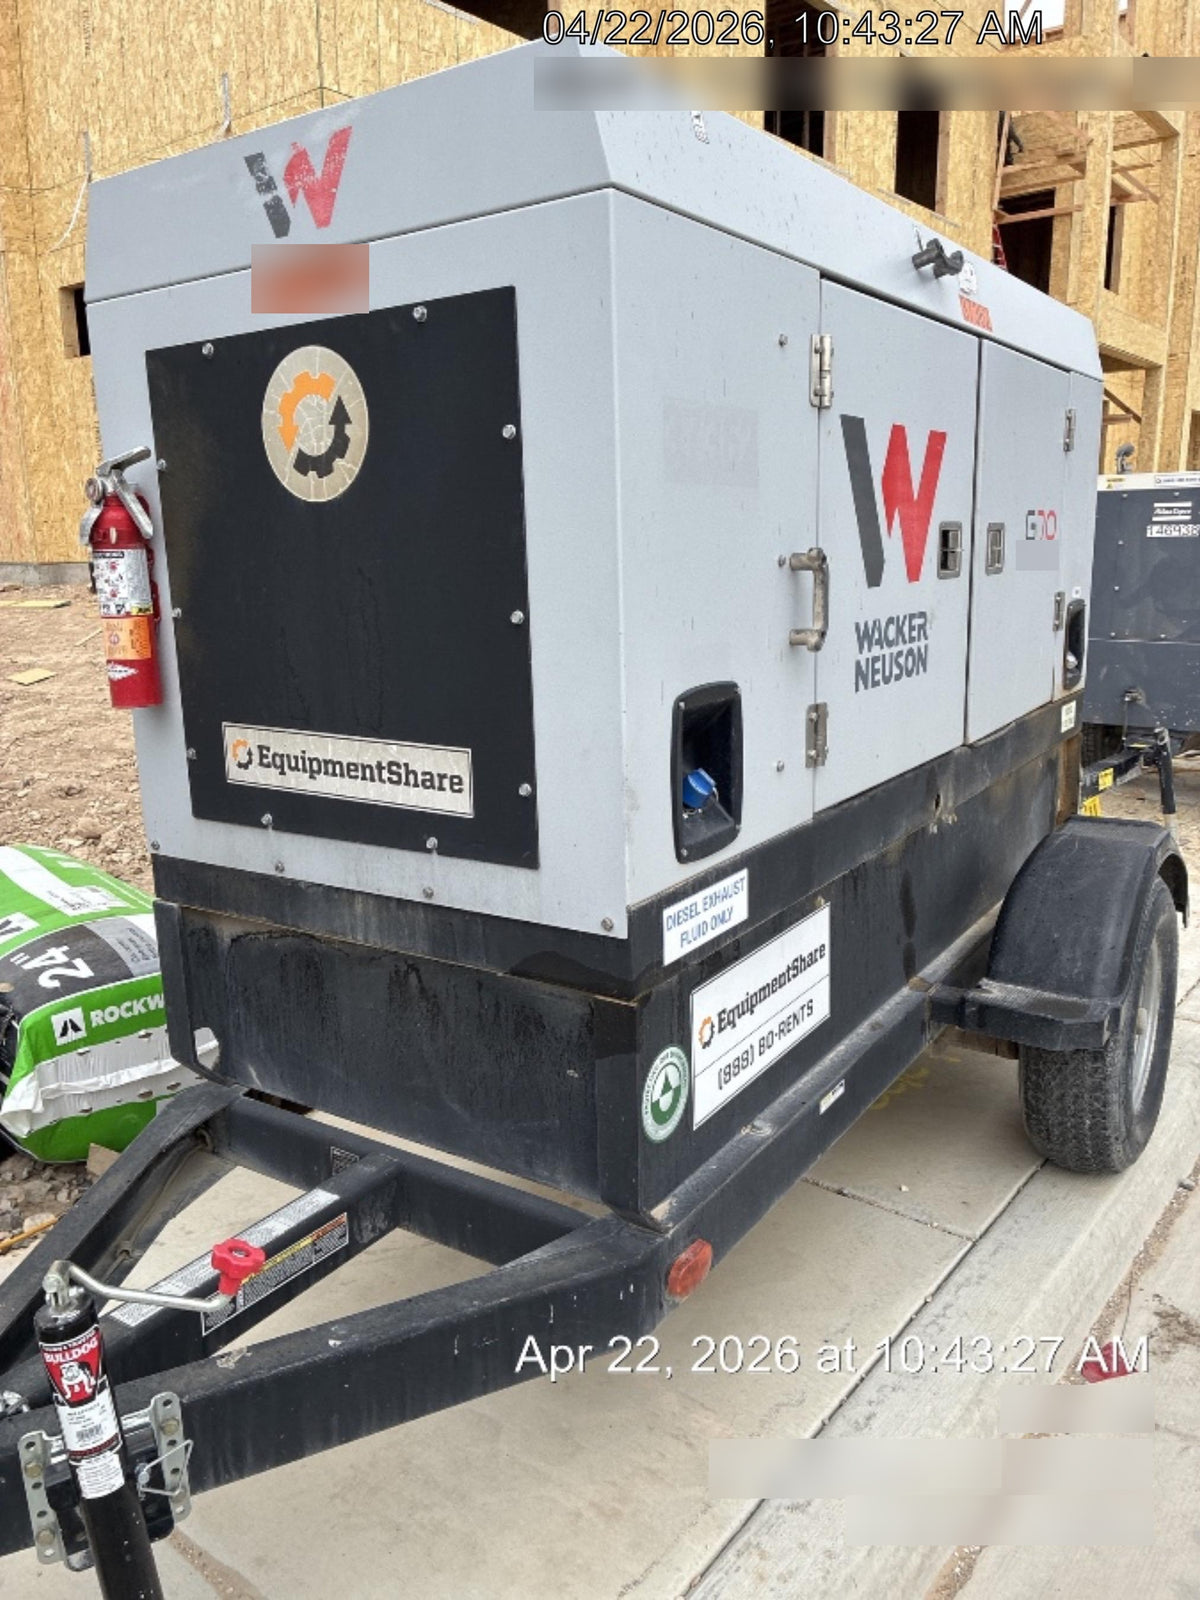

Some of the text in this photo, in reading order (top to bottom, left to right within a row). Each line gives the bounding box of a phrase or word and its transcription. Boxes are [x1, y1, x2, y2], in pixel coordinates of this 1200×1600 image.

[855, 611, 928, 655] WACKER
[855, 643, 928, 694] NEUSON
[257, 744, 464, 794] EquipmentShare
[666, 877, 745, 932] DIESEL EXHAUST
[680, 906, 734, 949] FLUID ONLY
[717, 942, 826, 1034] EquipmentShare
[718, 1044, 755, 1090] (888)
[43, 1336, 98, 1364] BULLDOG
